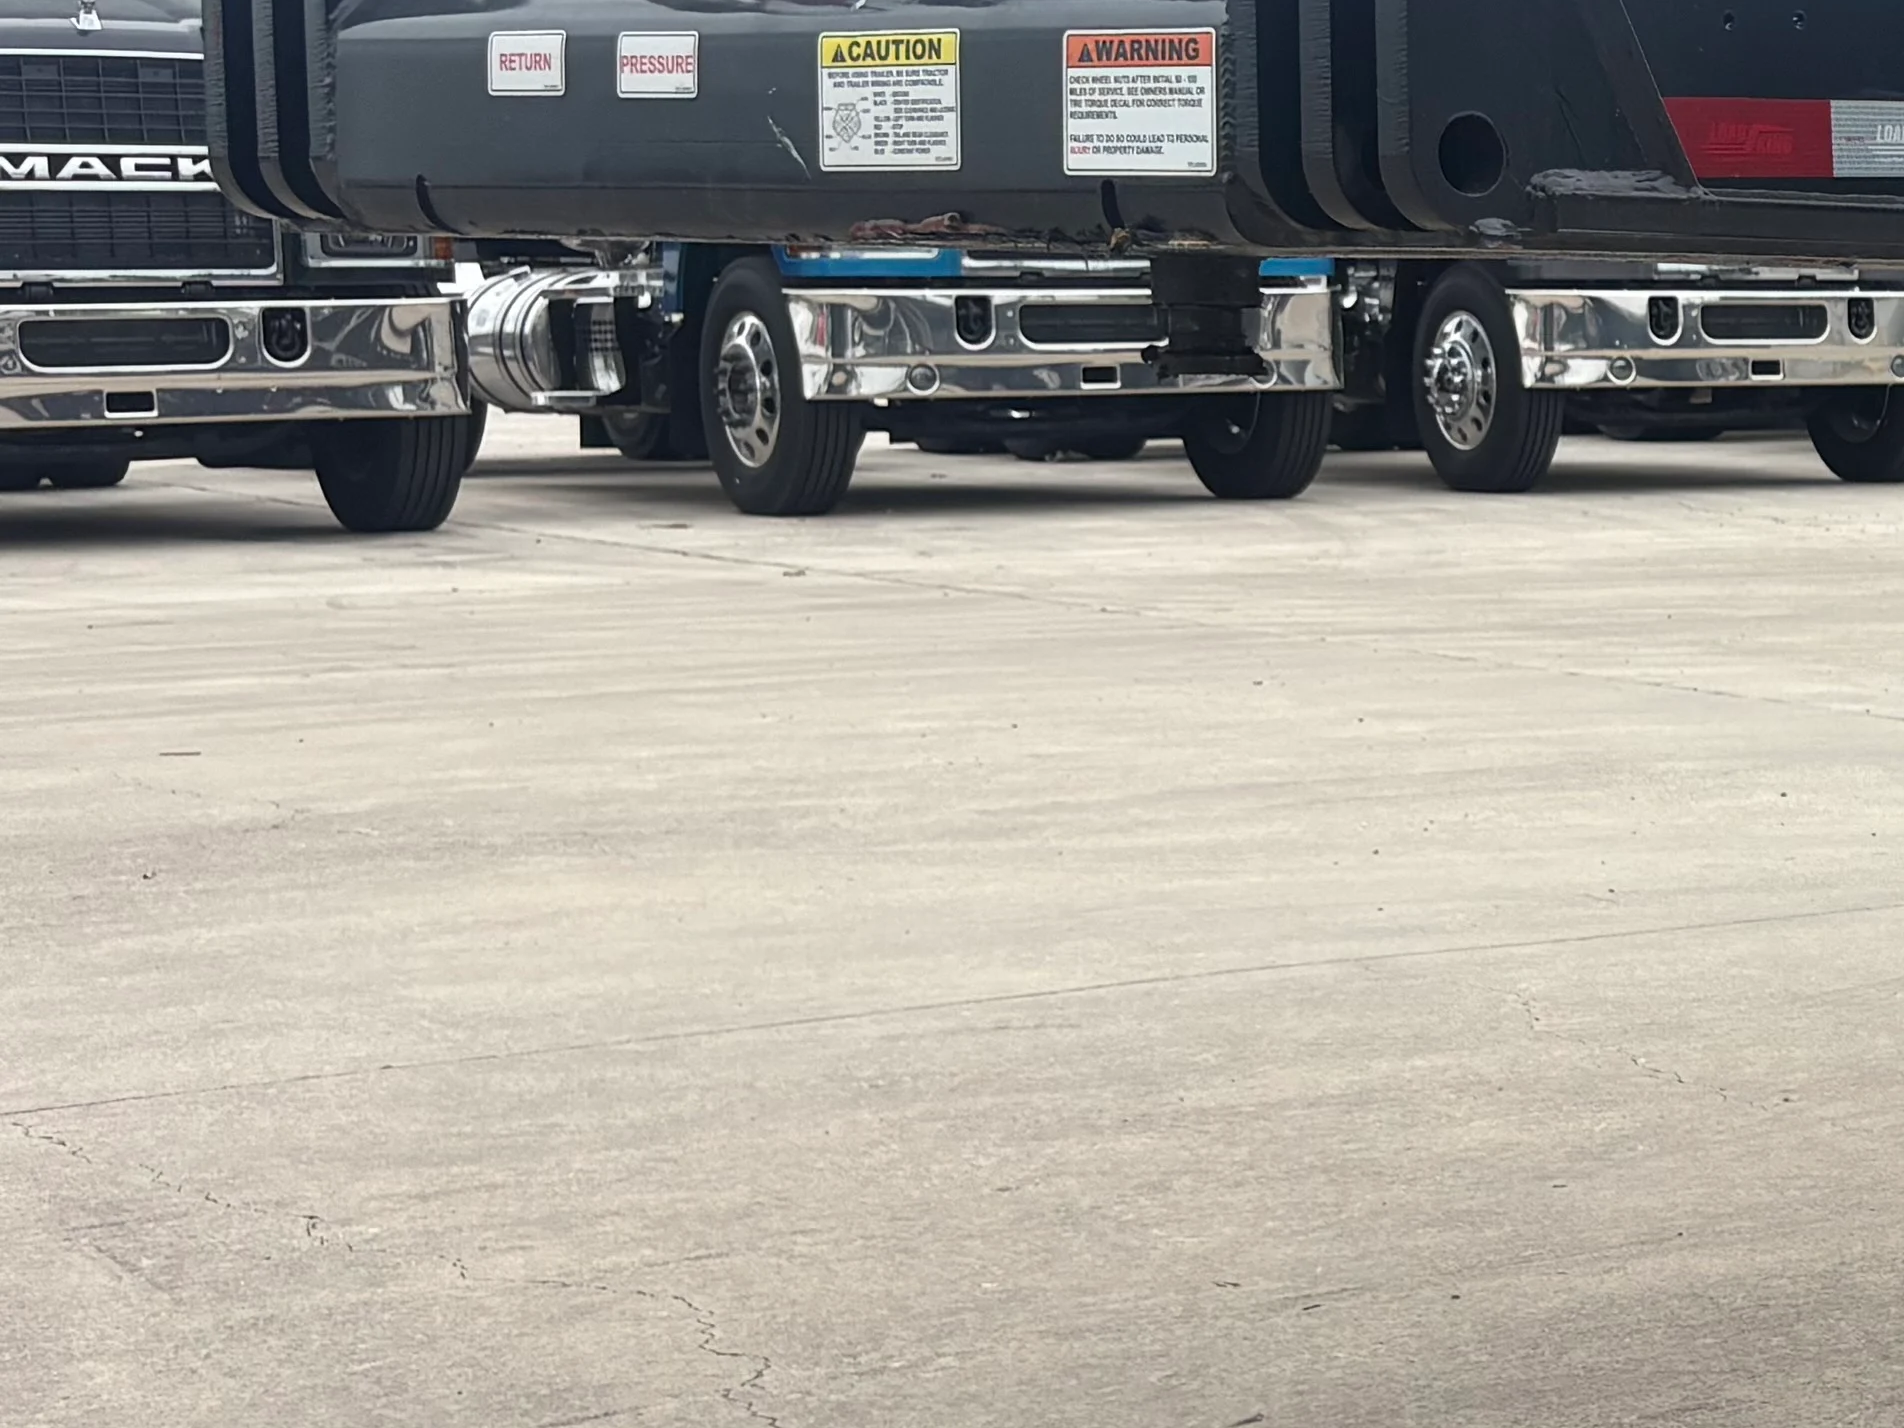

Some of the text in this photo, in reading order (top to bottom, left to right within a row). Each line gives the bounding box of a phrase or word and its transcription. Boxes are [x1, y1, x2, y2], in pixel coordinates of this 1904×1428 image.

[847, 38, 942, 62] CAUTION
[1095, 37, 1200, 62] WARNING
[500, 53, 551, 71] RETURN
[622, 55, 694, 73] PRESSURE
[0, 156, 214, 180] MACK
